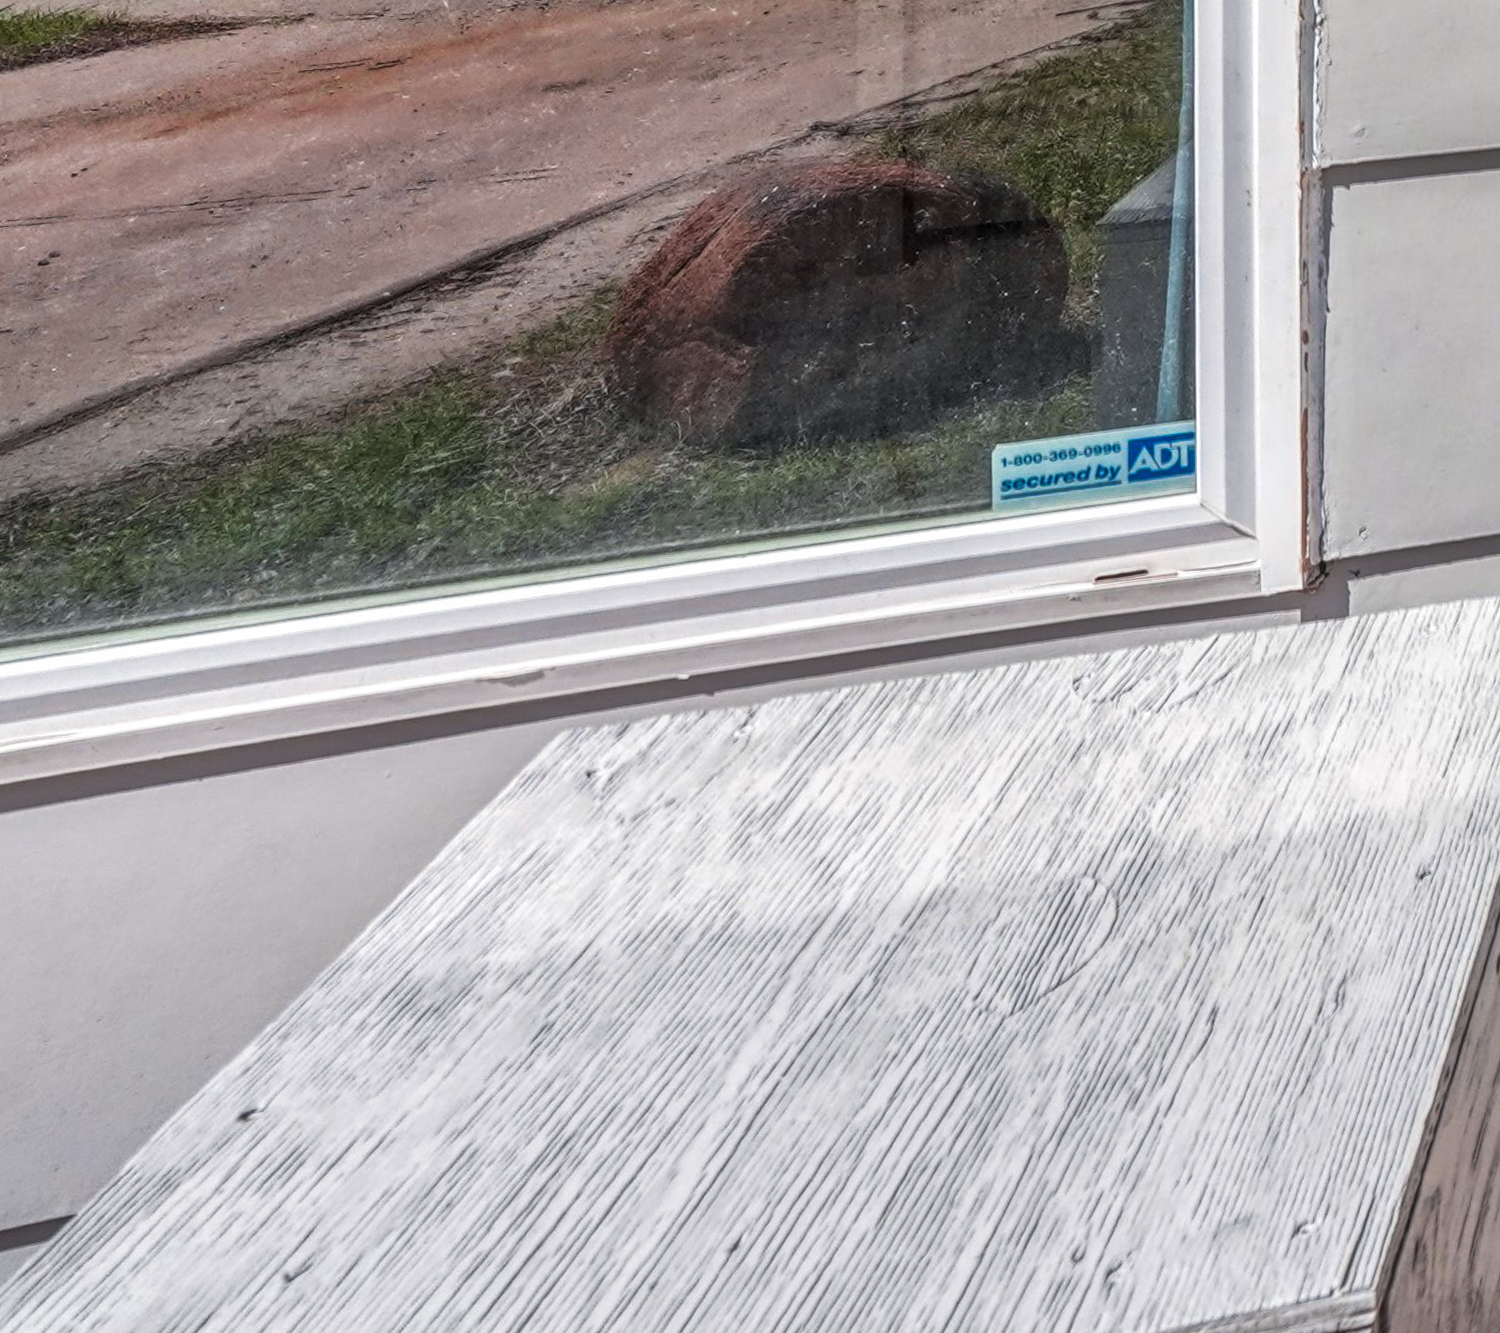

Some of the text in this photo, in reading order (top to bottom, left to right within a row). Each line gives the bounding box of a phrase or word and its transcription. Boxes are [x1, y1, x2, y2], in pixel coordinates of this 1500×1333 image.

[1001, 442, 1122, 469] 1-800-369-0996
[1129, 440, 1195, 475] ADT
[1000, 463, 1122, 493] secured by
